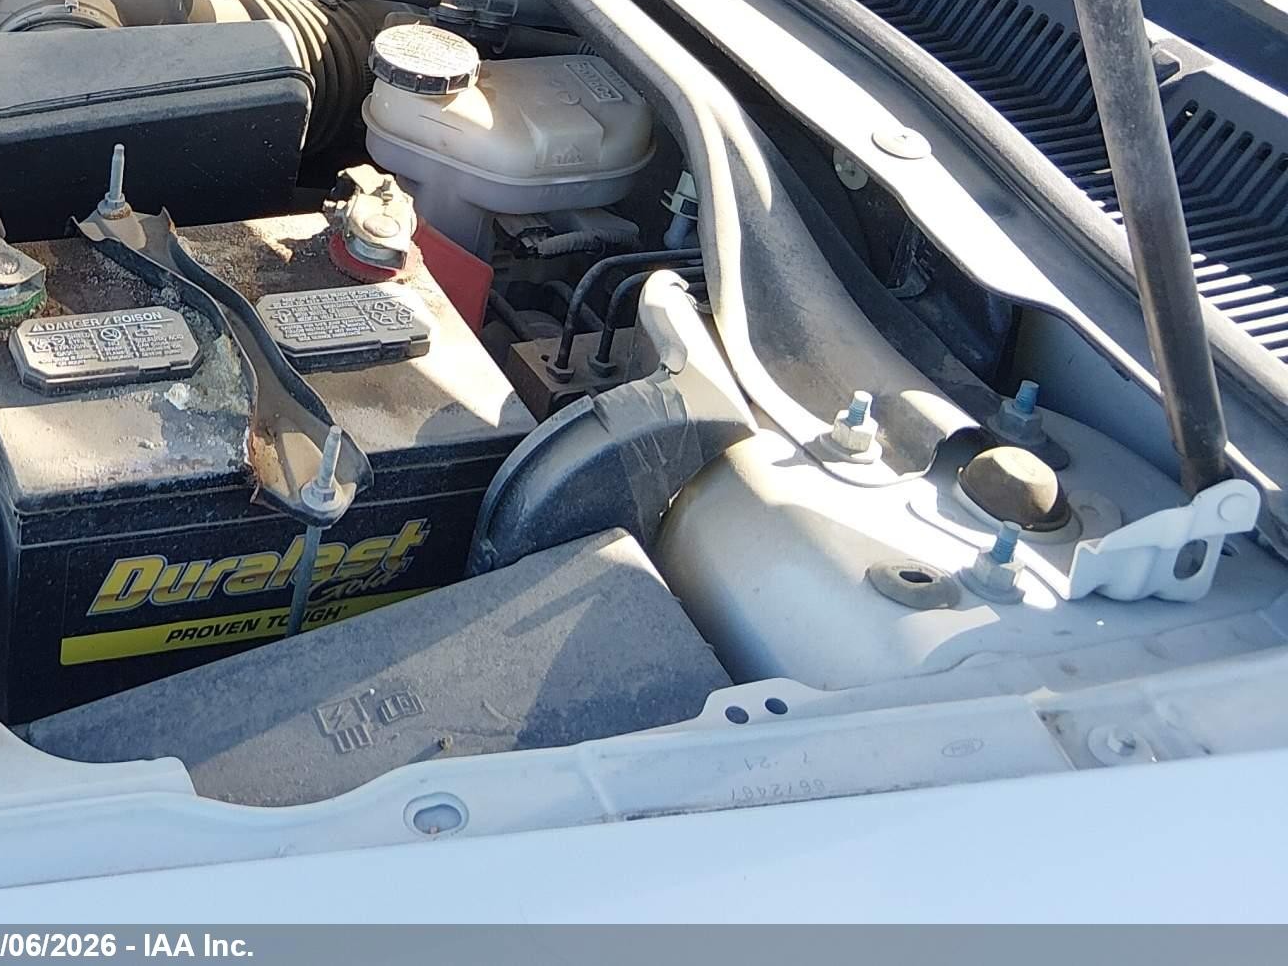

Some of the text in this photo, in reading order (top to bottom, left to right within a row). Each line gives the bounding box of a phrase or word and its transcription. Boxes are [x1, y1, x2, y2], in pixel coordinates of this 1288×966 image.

[45, 318, 101, 332] DANGER
[113, 311, 163, 324] POISON
[86, 518, 430, 616] Duralast
[165, 617, 261, 643] PROVEN
